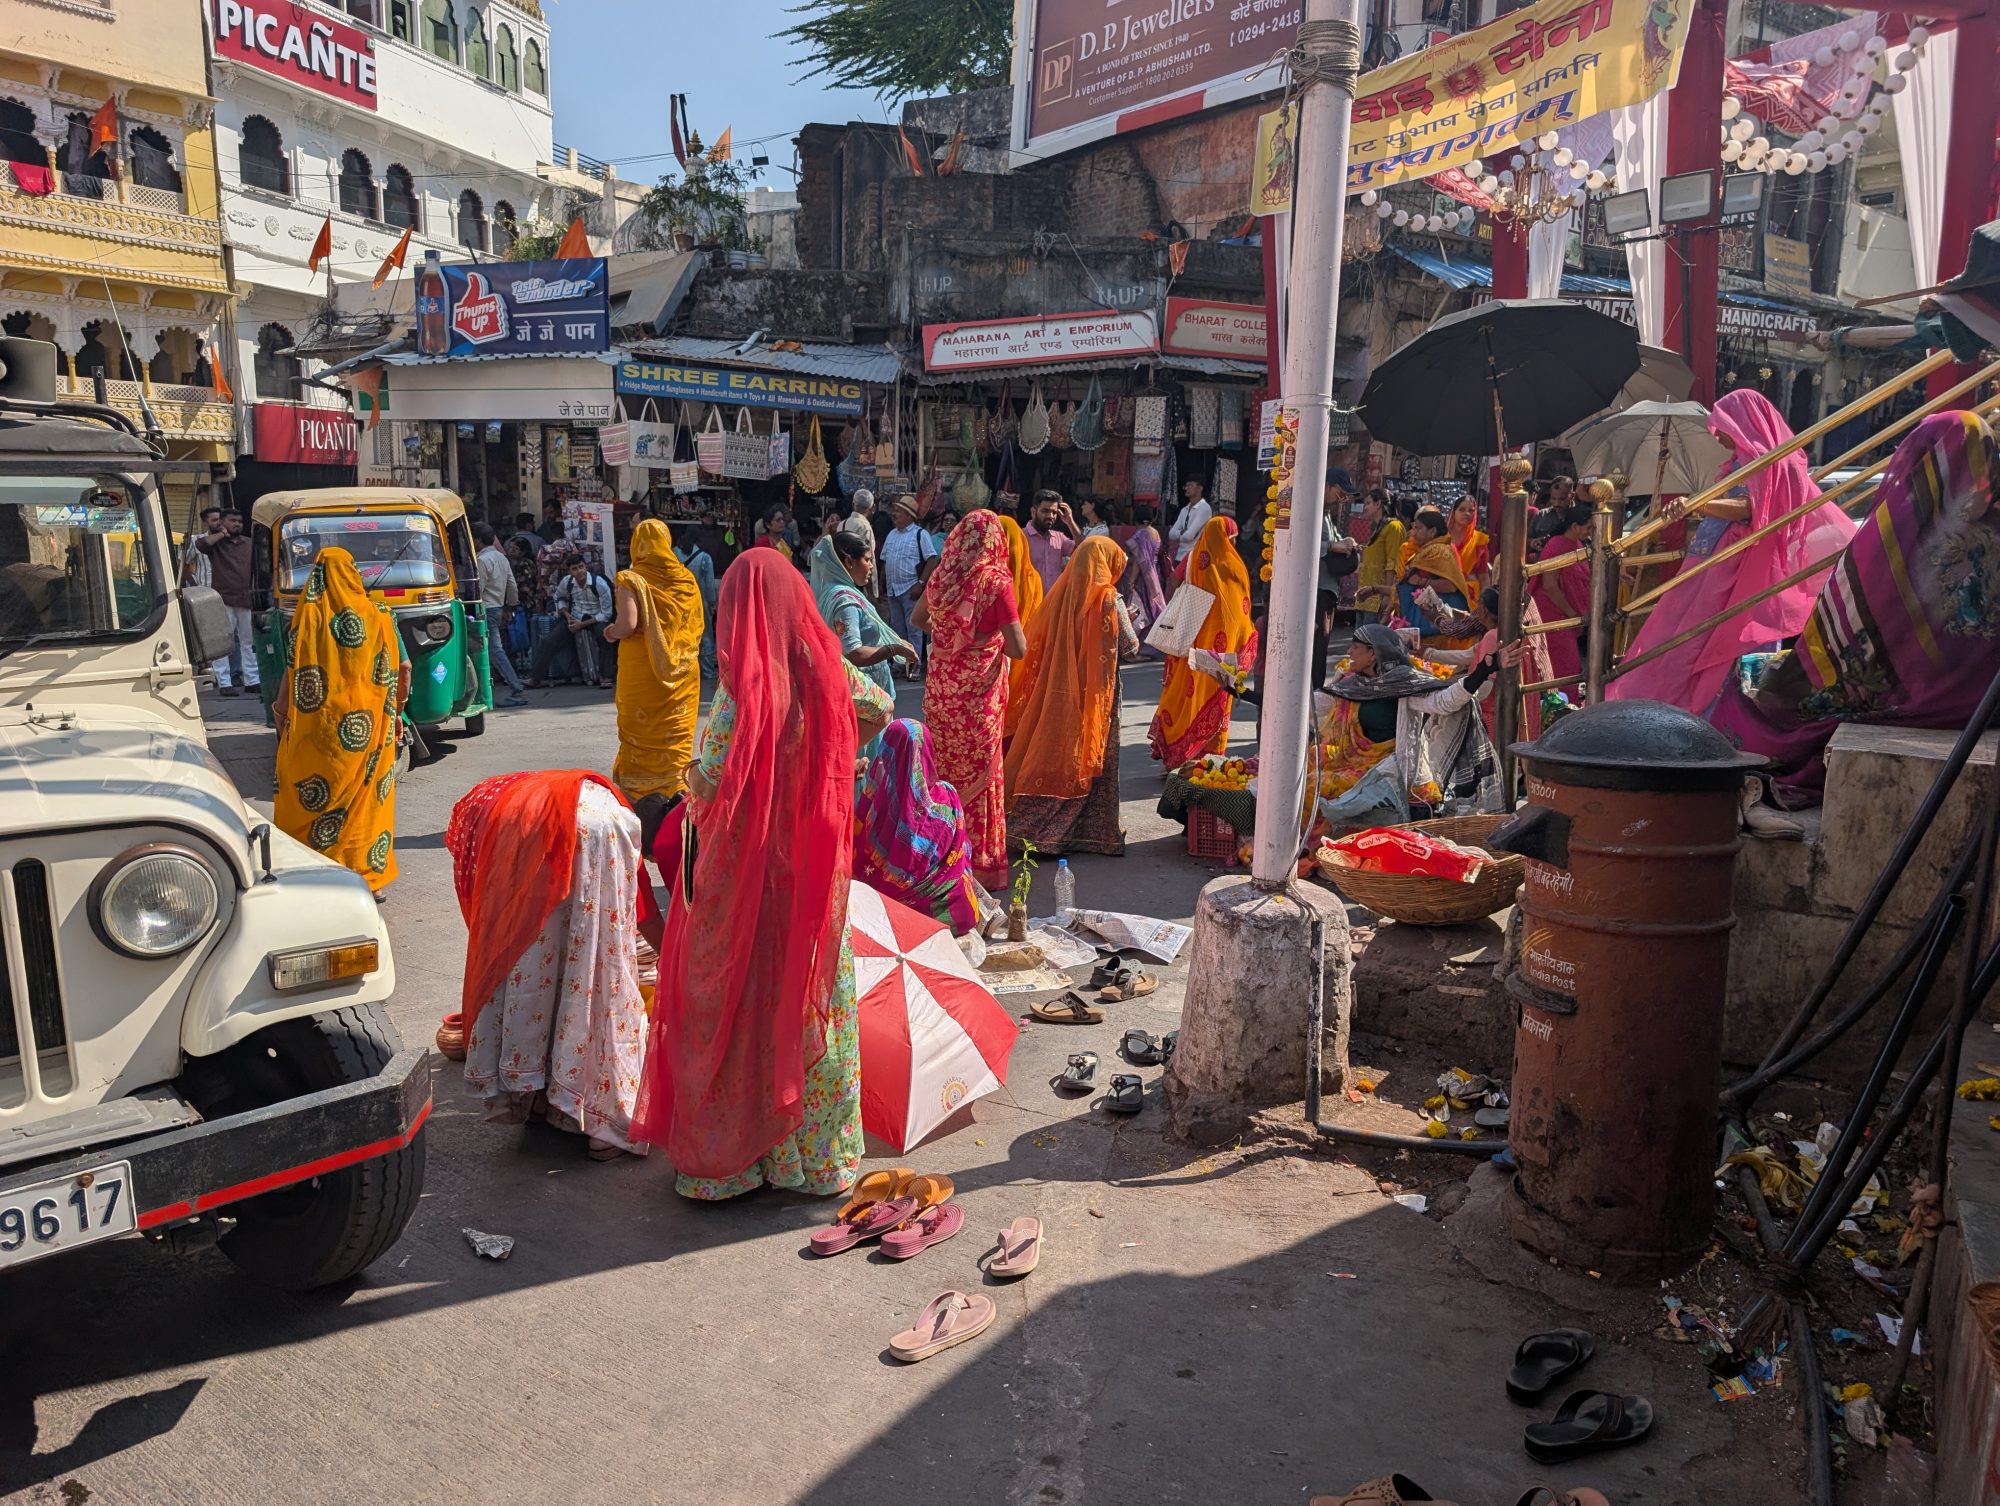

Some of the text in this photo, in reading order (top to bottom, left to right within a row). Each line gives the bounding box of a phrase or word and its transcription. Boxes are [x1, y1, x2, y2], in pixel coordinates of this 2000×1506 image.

[1120, 0, 1215, 52] Jewellers
[220, 1, 377, 95] PICAÑTE
[1131, 50, 1153, 63] TRUST
[1153, 38, 1174, 53] SINCE
[1042, 54, 1073, 94] DP
[1075, 89, 1080, 98] A
[1082, 76, 1116, 96] VENTURE
[1117, 73, 1127, 84] OF
[1145, 49, 1193, 74] ABHUSHAN
[1194, 42, 1213, 57] LTD.
[1351, 0, 1614, 123] वाड़ सेना
[1089, 90, 1118, 106] Customer
[1384, 112, 1460, 148] सुभाष
[1466, 91, 1518, 120] सेवा
[1522, 52, 1602, 97] समिति
[456, 300, 496, 322] Thums
[1184, 313, 1227, 327] BHARAT
[1721, 308, 1817, 332] HANDICRAFTS
[516, 320, 597, 341] जे जे पान
[942, 321, 1133, 347] MAHARANA ART & EMPORIUM
[1210, 332, 1233, 344] भारत
[1741, 327, 1754, 337] (P)
[1757, 329, 1778, 338] LTD.
[953, 334, 1122, 360] महाराणा आर्ट एण्ड एम्पोरियम
[622, 364, 862, 399] SHREE EARRING
[559, 400, 610, 417] जे जे पान
[1217, 826, 1233, 835] 58
[1530, 965, 1576, 991] India Post
[1556, 960, 1575, 976] डाक
